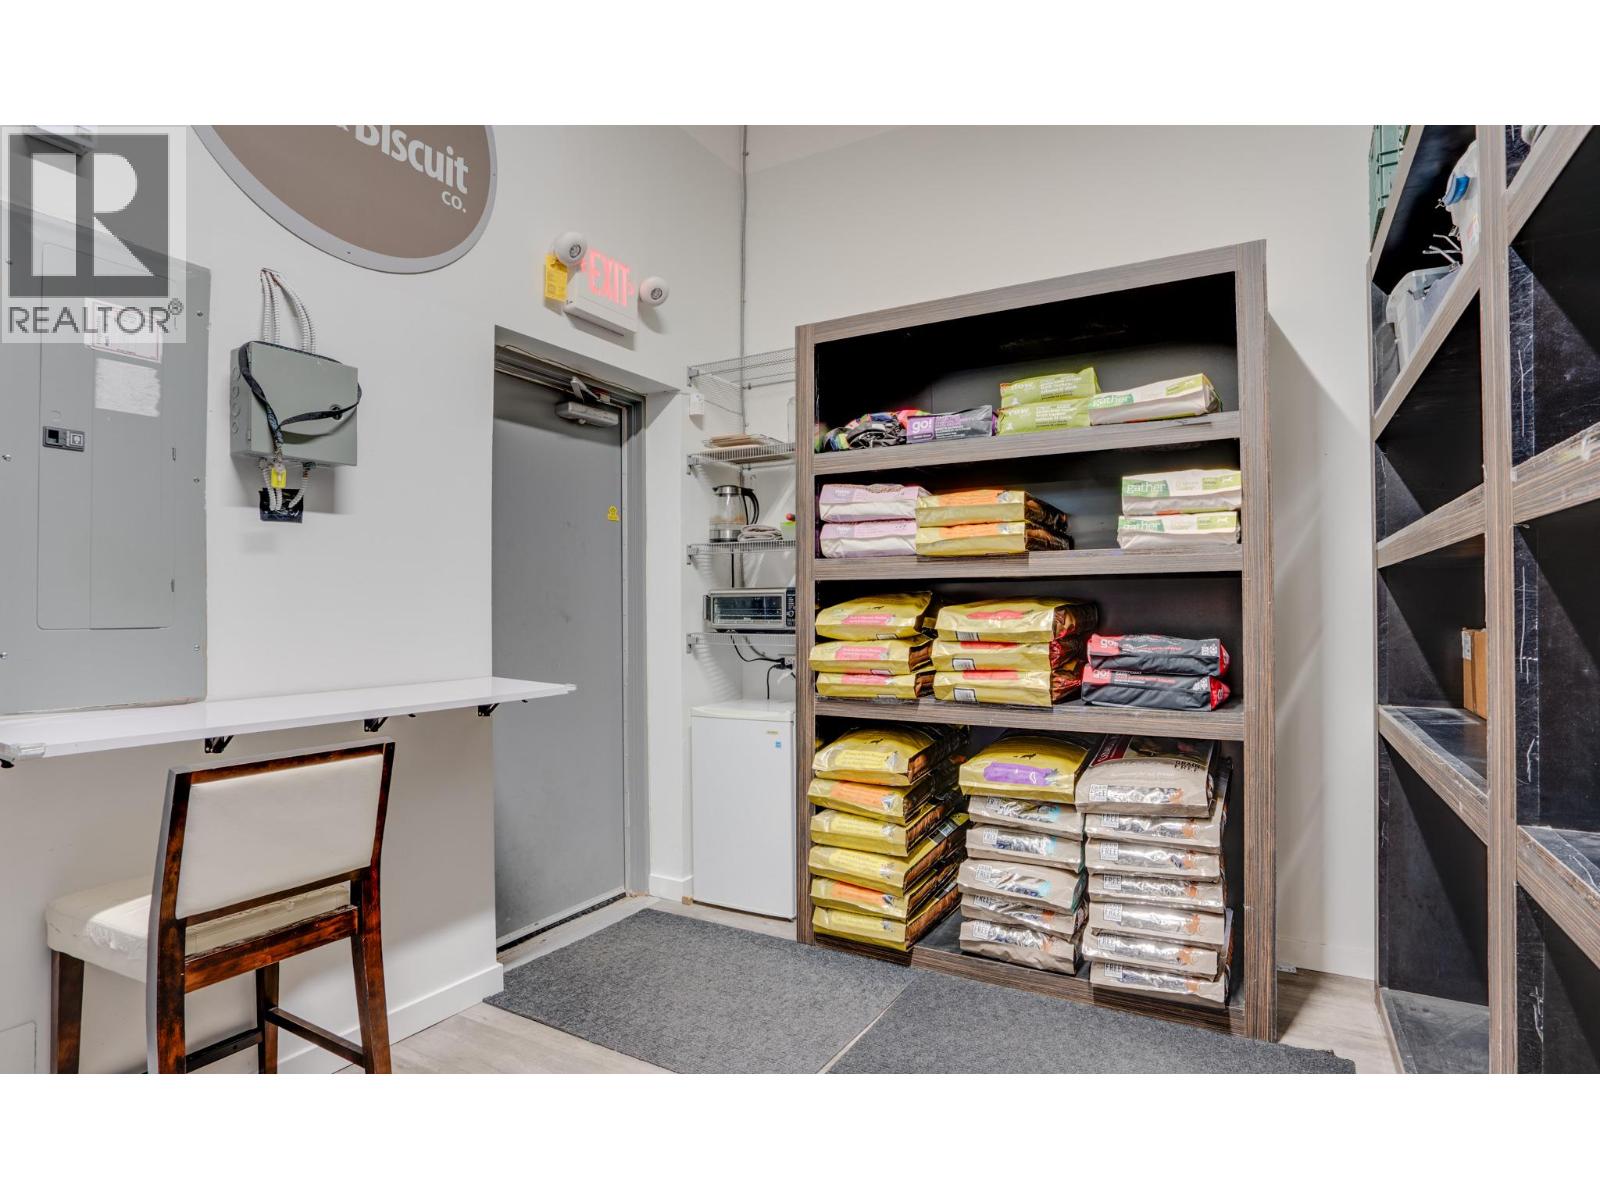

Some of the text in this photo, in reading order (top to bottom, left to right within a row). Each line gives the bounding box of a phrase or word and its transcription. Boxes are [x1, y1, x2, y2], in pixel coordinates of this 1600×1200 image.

[588, 249, 632, 306] EXIT
[911, 418, 932, 434] go!
[1126, 480, 1167, 494] gather
